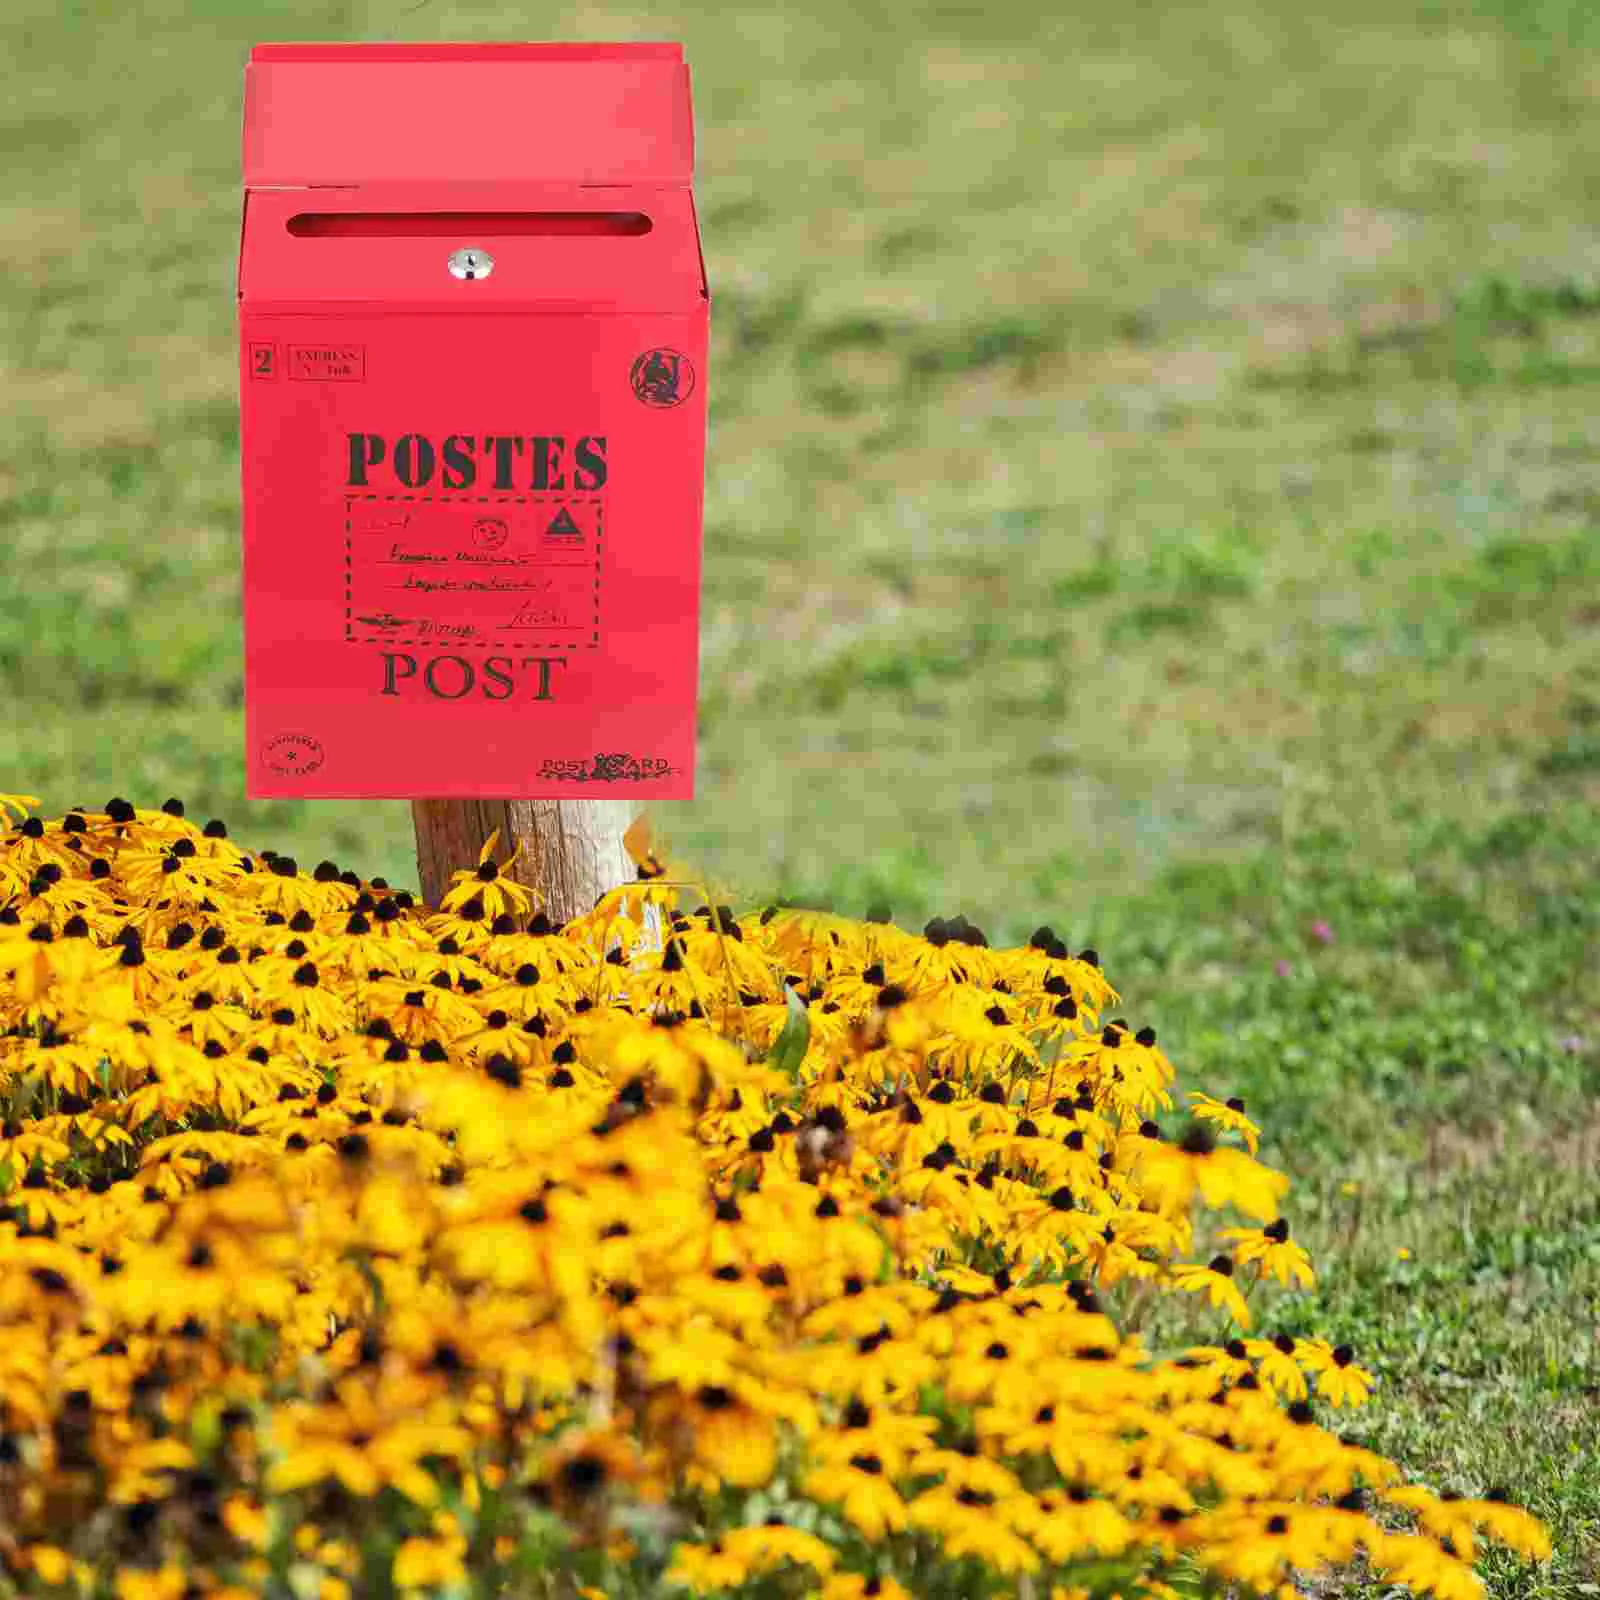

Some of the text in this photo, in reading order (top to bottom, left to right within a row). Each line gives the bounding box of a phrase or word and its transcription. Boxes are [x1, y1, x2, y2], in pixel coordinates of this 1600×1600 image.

[255, 350, 273, 373] 2
[345, 432, 609, 491] POSTES
[379, 651, 568, 702] POST
